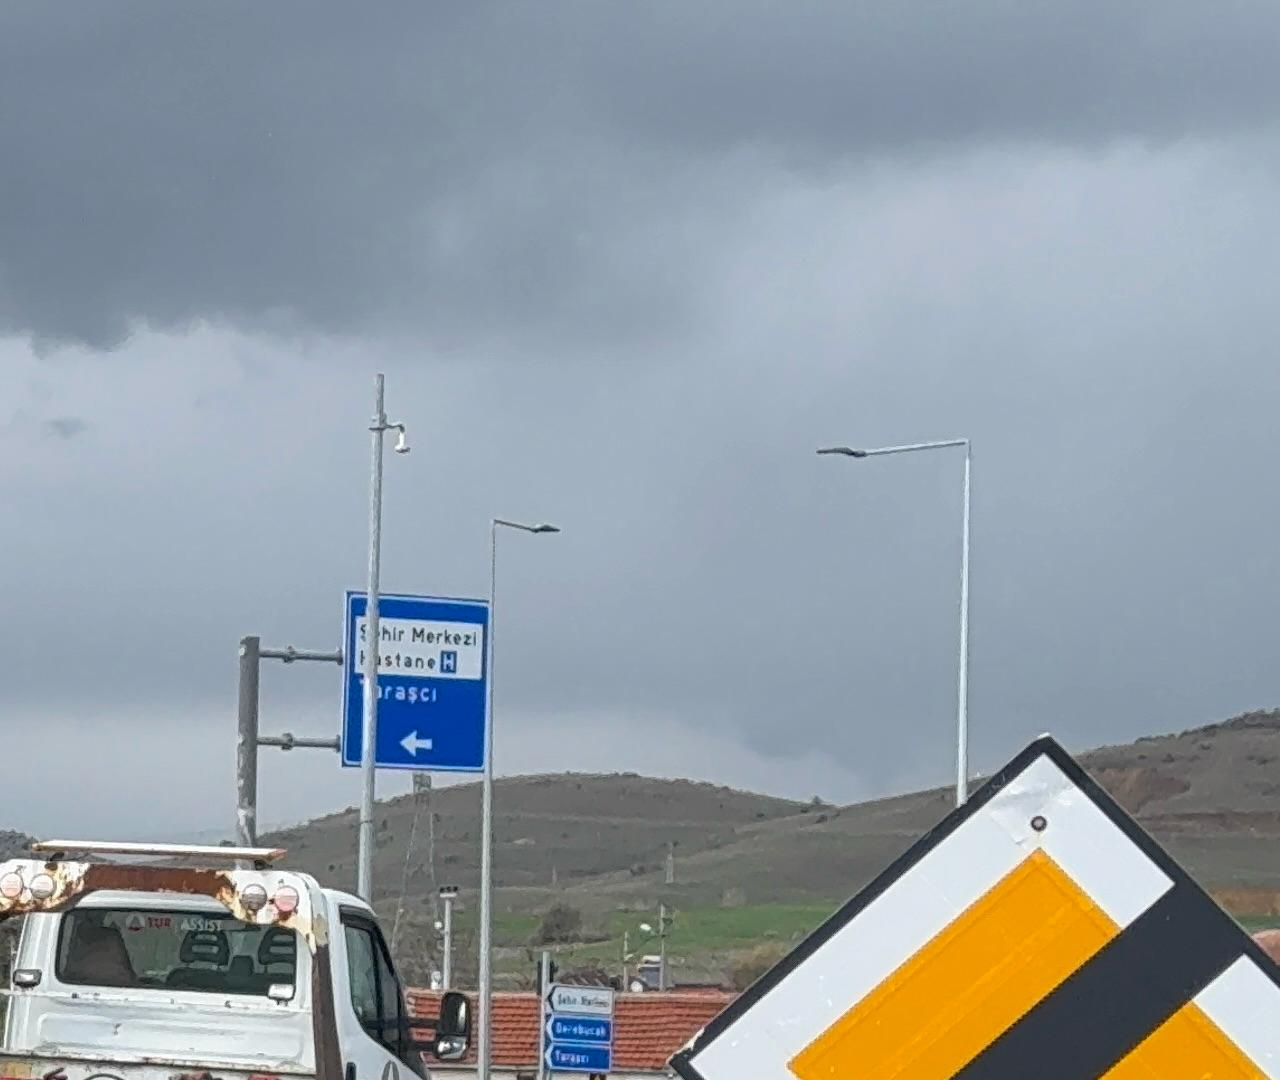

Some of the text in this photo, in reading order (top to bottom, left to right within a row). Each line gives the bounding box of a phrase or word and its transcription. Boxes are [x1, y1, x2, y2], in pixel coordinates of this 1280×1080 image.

[360, 624, 477, 646] Şhir Merkezi
[360, 650, 436, 669] stane
[360, 679, 437, 704] raşcı
